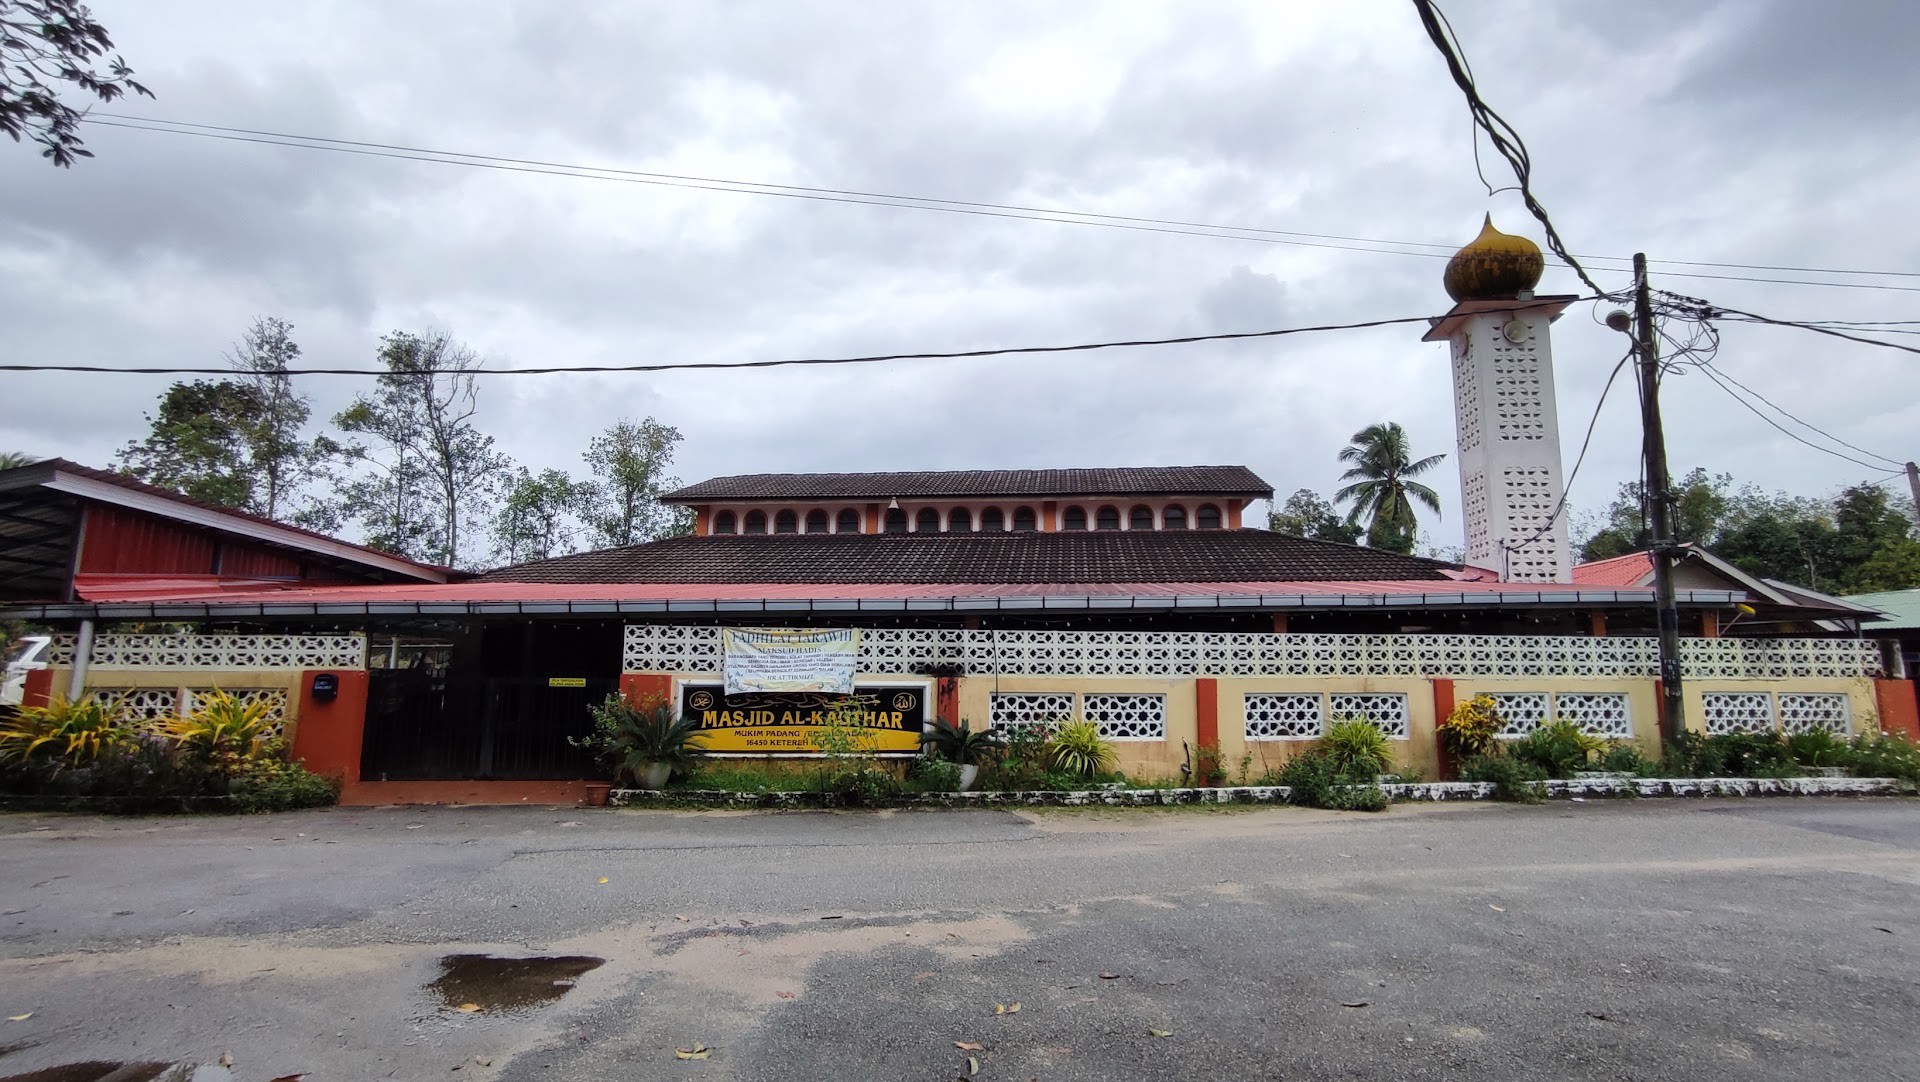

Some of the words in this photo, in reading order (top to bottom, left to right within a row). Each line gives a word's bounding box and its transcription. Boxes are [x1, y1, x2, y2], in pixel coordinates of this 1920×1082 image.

[732, 632, 791, 643] FADHILAT
[796, 631, 852, 643] TARAWIH
[701, 710, 775, 729] MASJID
